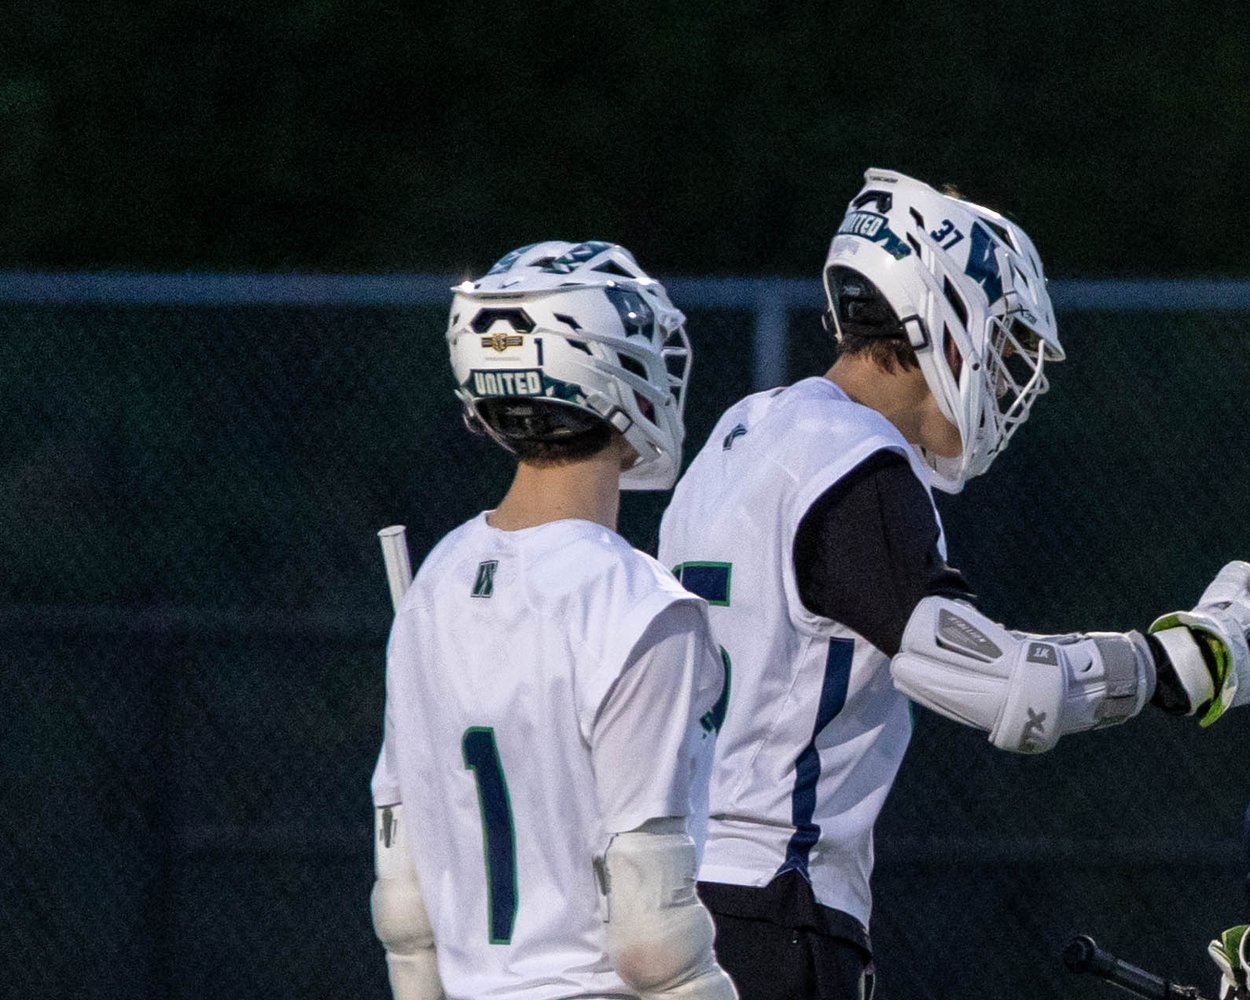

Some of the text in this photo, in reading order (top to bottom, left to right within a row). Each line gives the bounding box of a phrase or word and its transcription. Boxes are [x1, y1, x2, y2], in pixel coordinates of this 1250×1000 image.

[930, 219, 964, 250] 37
[533, 337, 544, 366] 1
[474, 371, 542, 395] UNITED
[461, 725, 519, 946] 1
